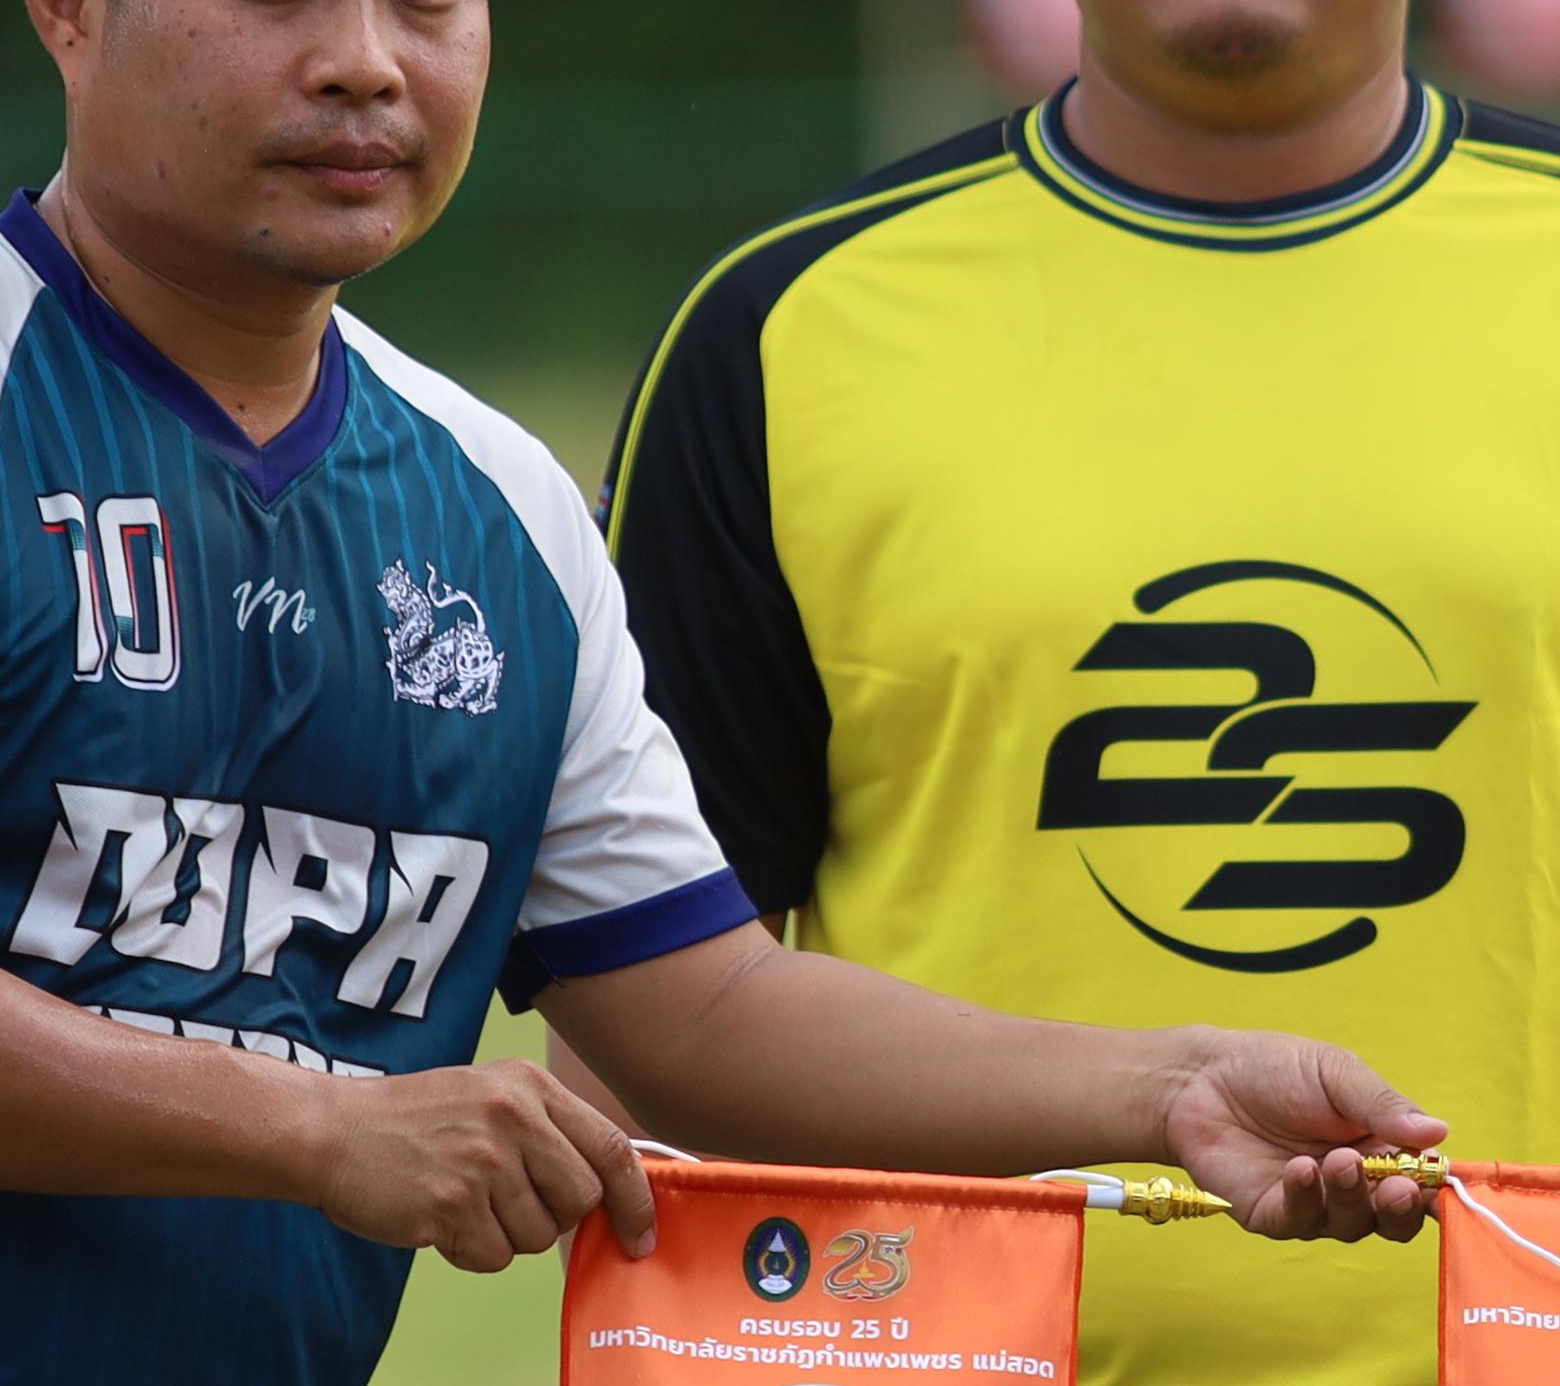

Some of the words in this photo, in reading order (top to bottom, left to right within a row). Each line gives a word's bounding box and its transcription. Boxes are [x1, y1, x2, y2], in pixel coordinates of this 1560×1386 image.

[10, 782, 490, 1019] DOPA
[588, 1324, 963, 1373] มหาวิทยาลัยราชภัฏกำแพงเพชร
[972, 1349, 1056, 1380] แม่สอด
[739, 1316, 841, 1340] ครบรอบ
[850, 1318, 881, 1340] 25
[890, 1316, 911, 1342] ปี
